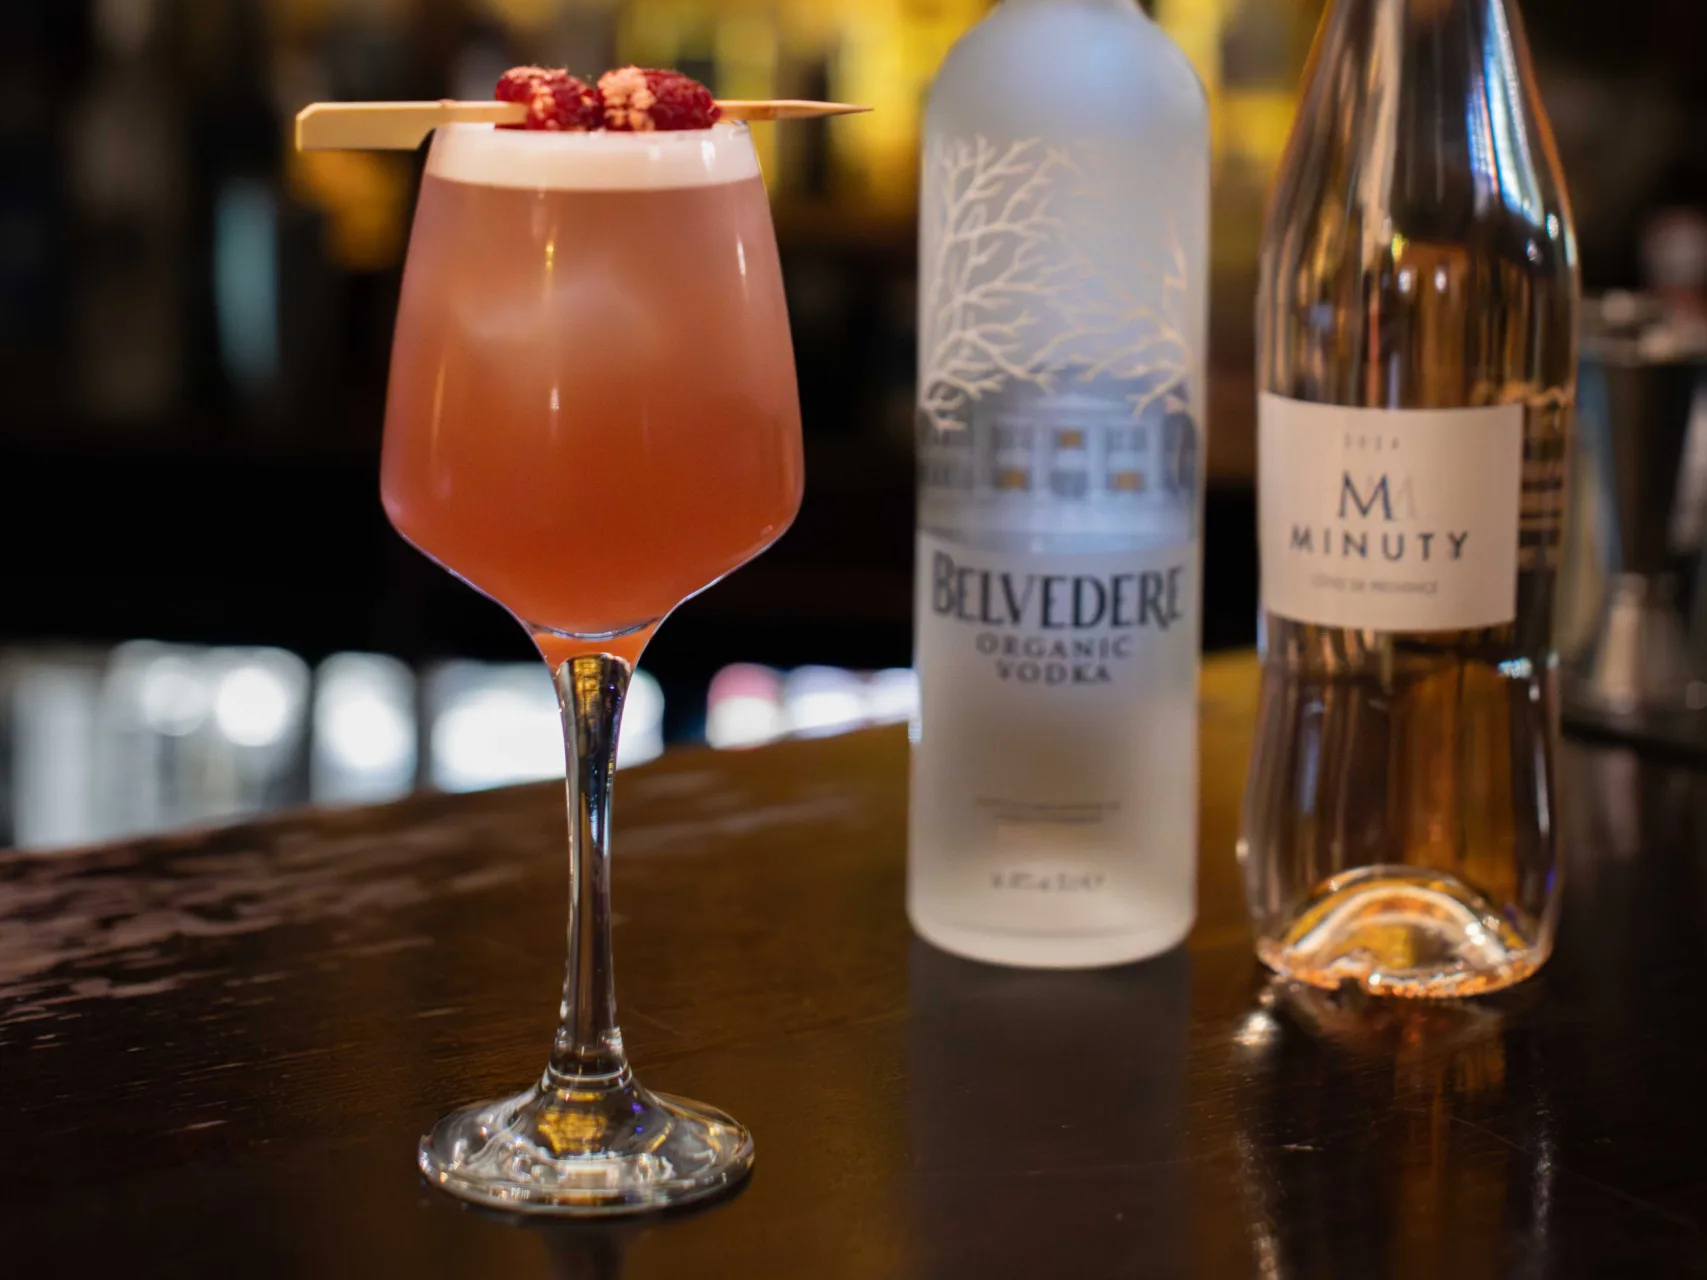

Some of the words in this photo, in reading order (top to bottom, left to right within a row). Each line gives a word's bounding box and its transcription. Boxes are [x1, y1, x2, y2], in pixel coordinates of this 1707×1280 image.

[1290, 525, 1467, 561] MINUTY
[933, 550, 1184, 629] BELVEDERE
[975, 632, 1132, 659] ORGANIC
[996, 659, 1111, 685] VODKA
